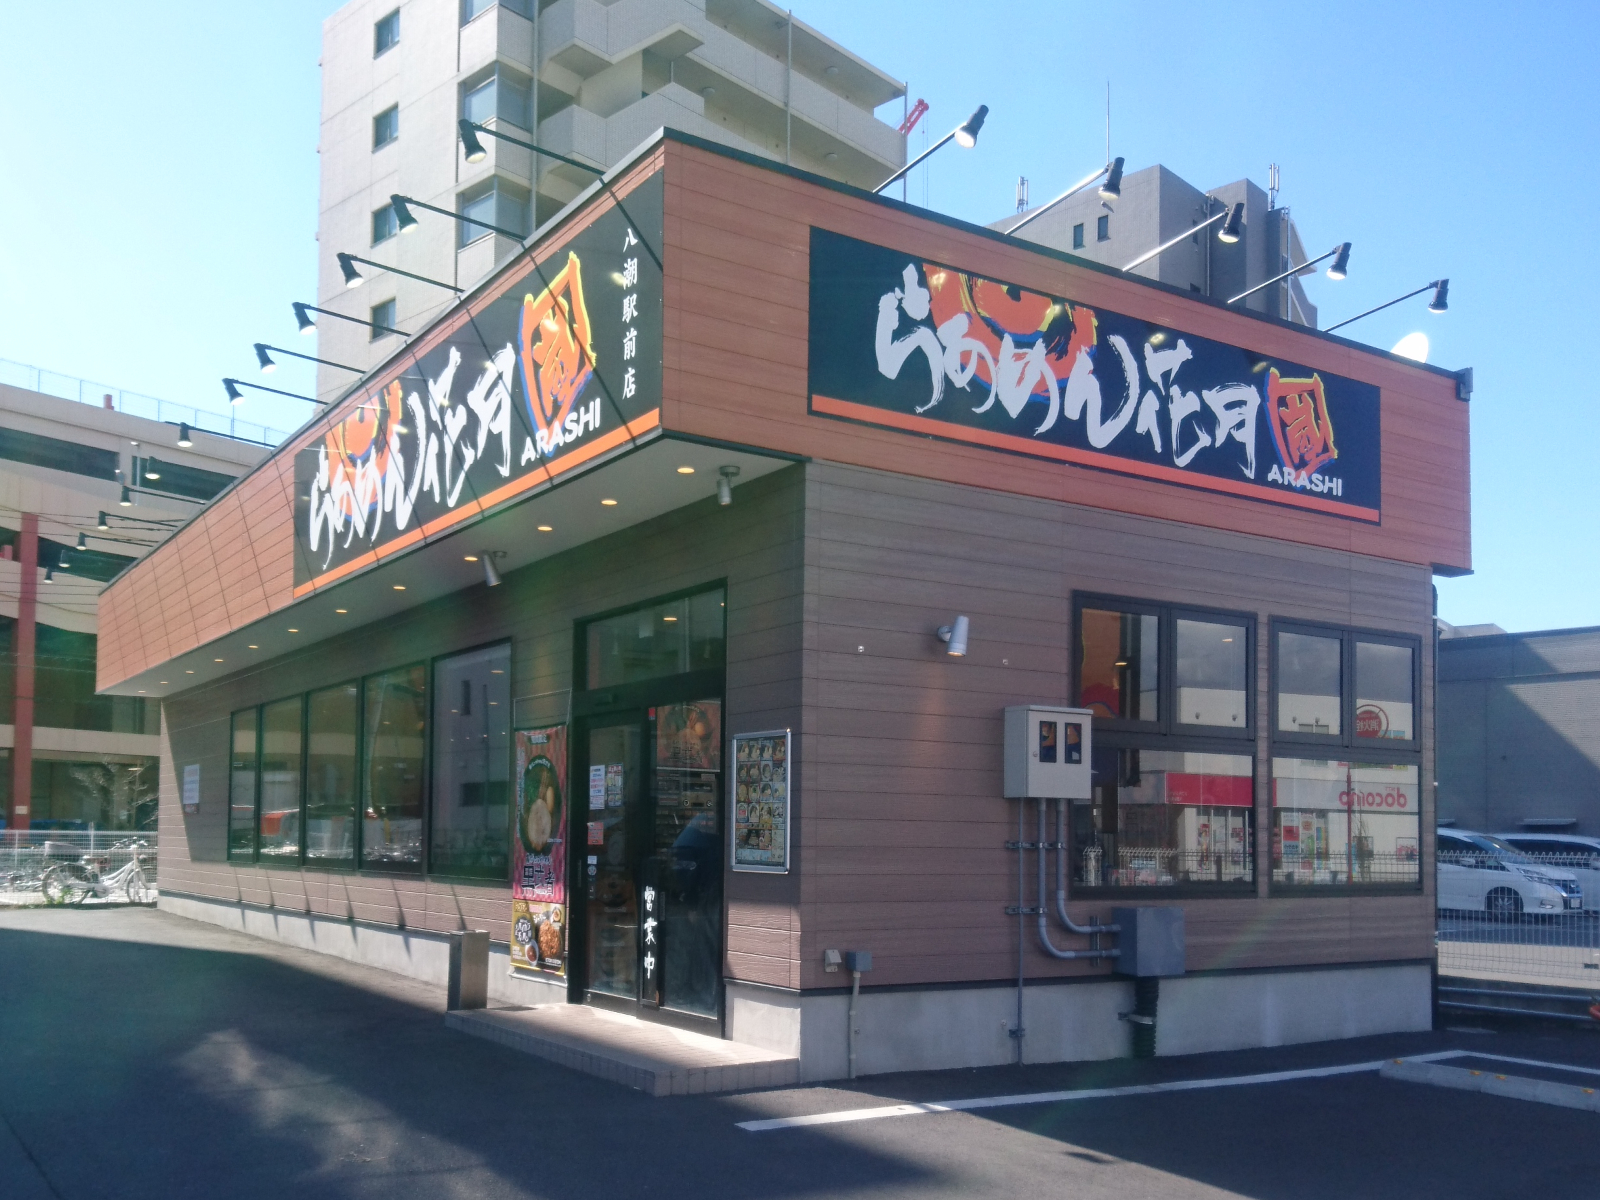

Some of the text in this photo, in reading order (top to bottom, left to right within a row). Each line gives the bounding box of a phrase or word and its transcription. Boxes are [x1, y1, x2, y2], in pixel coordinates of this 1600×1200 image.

[622, 228, 639, 400] 八潮駅前店
[520, 397, 602, 467] ARASHI
[1267, 465, 1344, 497] ARASHI
[643, 885, 658, 980] 営業中
